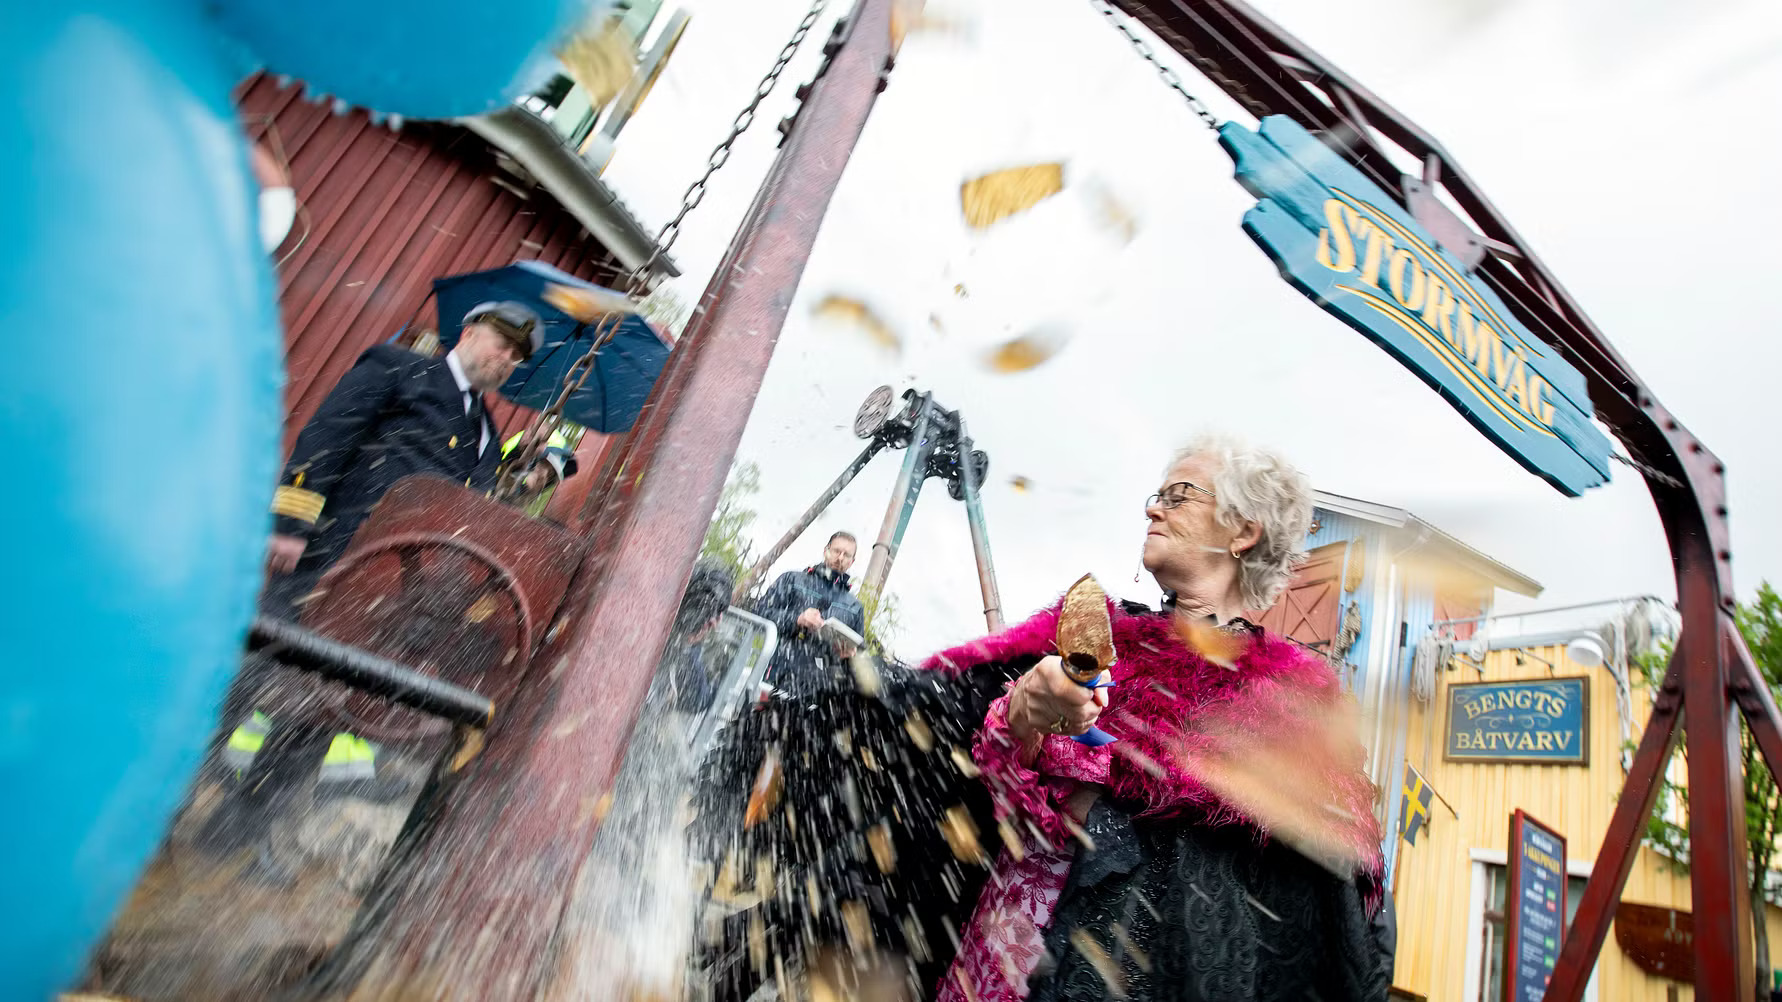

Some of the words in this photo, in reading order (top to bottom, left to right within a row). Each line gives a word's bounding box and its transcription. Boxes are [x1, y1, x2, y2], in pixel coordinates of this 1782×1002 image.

[1316, 198, 1557, 427] STORMVÅG
[1464, 690, 1566, 719] BENGTS
[1456, 728, 1572, 750] BÅTVARV
